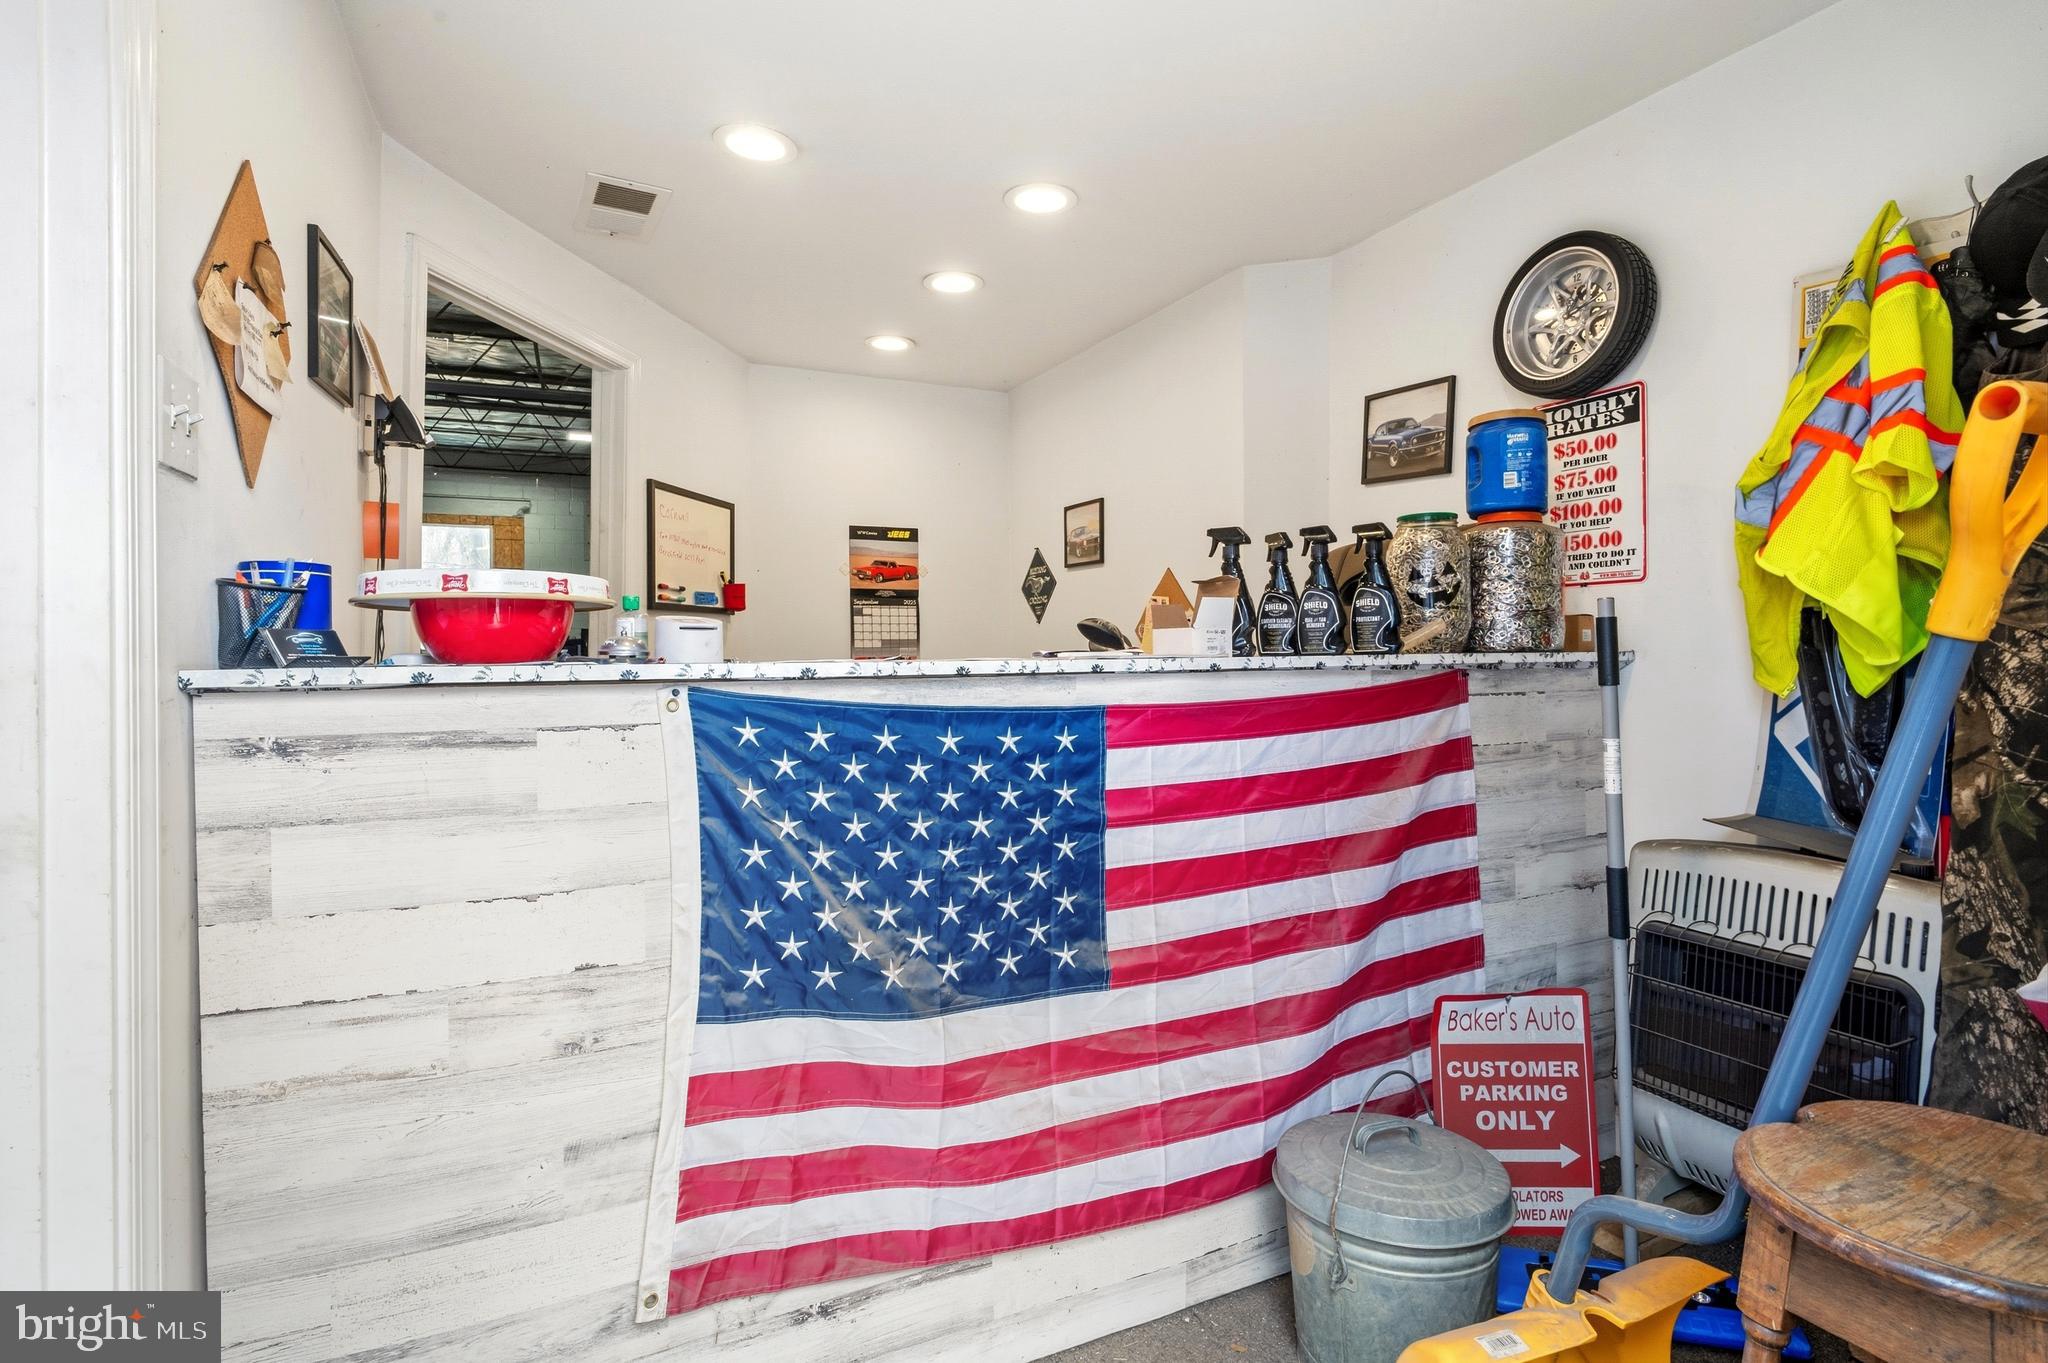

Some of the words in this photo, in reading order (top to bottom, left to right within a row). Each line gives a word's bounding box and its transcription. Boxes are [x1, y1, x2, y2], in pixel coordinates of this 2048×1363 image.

[1573, 272, 1582, 282] 12
[1606, 281, 1613, 291] 2
[1572, 354, 1578, 363] 6
[1547, 409, 1625, 438] RATES
[1553, 432, 1617, 460] $50.00
[1563, 459, 1581, 468] PER
[1583, 454, 1608, 465] HOUR
[1554, 465, 1617, 492] $75.00
[1567, 489, 1584, 499] YOU
[1586, 484, 1616, 495] WATCH
[1550, 497, 1622, 523] $100.00
[1570, 520, 1587, 528] YOU
[1590, 517, 1612, 526] HELP
[1563, 530, 1622, 552] 150.00
[1567, 552, 1593, 562] TRIED
[1596, 551, 1608, 559] TO
[1610, 549, 1624, 557] DO
[1627, 548, 1637, 556] IT
[1568, 562, 1586, 571] AND
[1588, 558, 1631, 569] COULDN'T
[1303, 601, 1328, 610] SHIELD
[1355, 598, 1380, 608] SHIELD
[1447, 1005, 1518, 1032] Baker's
[1525, 1006, 1575, 1032] Auto
[1446, 1060, 1580, 1078] CUSTOMER
[1459, 1084, 1569, 1102] PARKING
[1475, 1110, 1556, 1131] ONLY
[1511, 1190, 1564, 1202] OLATORS
